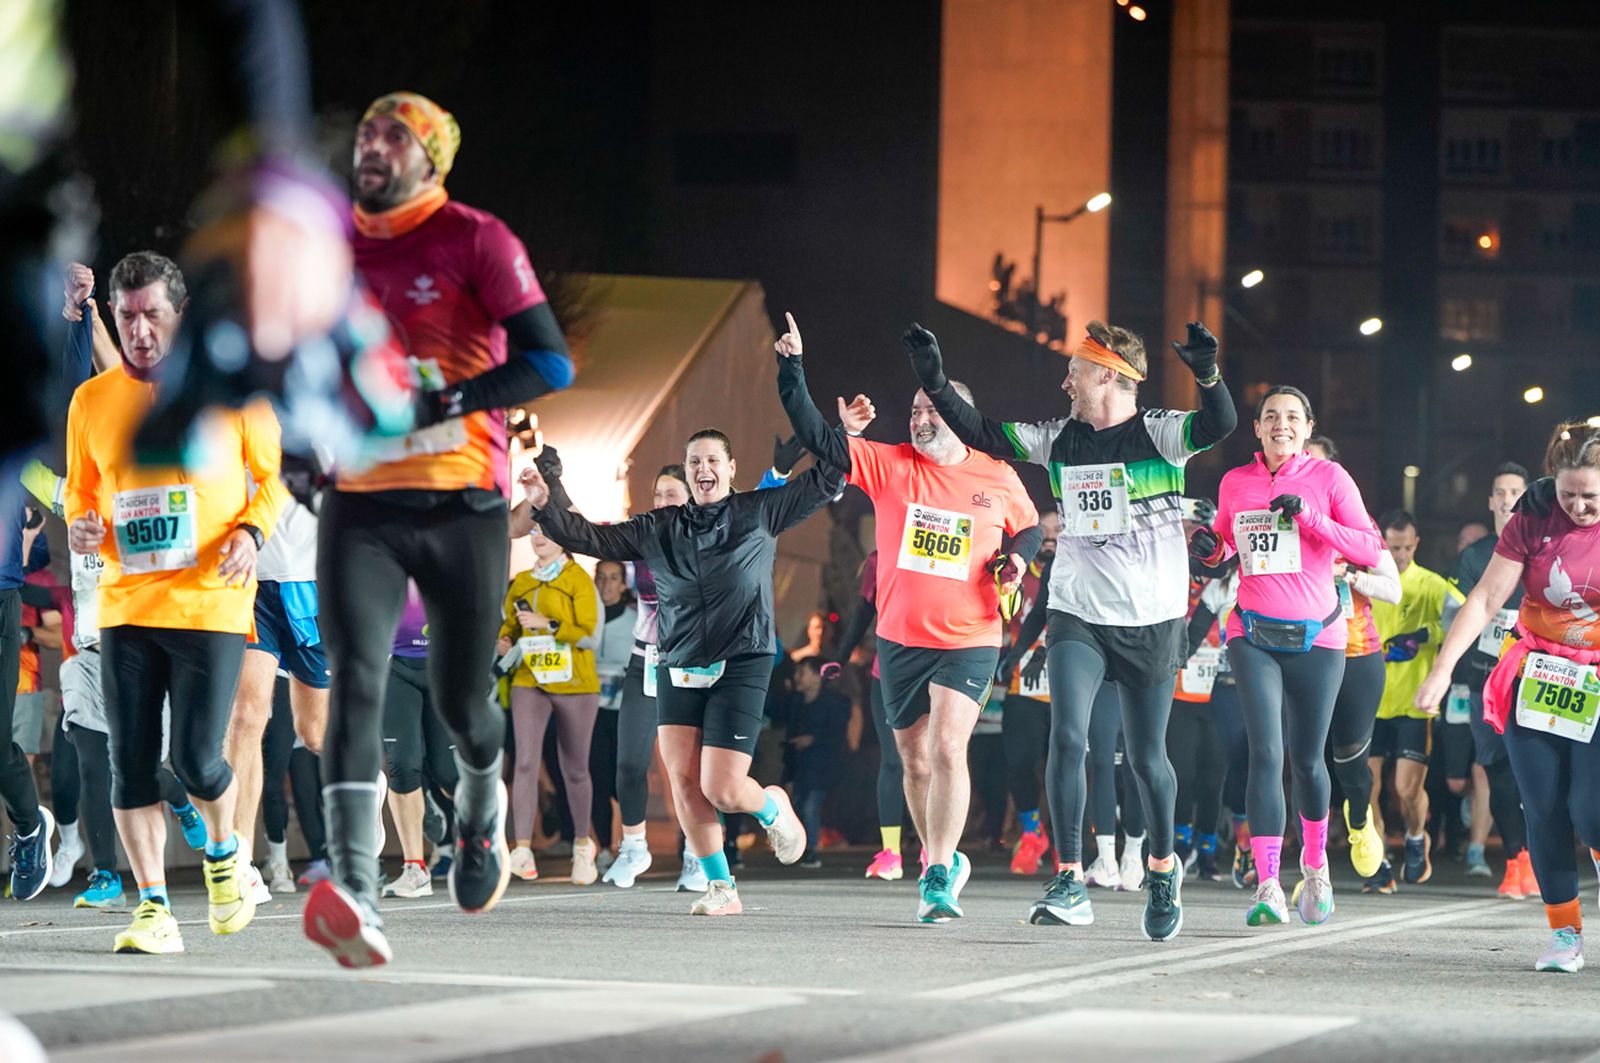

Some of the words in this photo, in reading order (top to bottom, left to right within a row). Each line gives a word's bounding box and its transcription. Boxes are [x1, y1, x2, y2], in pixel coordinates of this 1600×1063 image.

[1095, 472, 1104, 480] DE
[126, 498, 148, 508] NOCHE
[150, 496, 159, 505] DE
[1078, 489, 1112, 512] 336
[912, 520, 926, 528] SN
[921, 513, 941, 523] NOCHE
[1246, 516, 1263, 524] NOCHE
[126, 516, 178, 545] 9507
[913, 529, 962, 556] 5666
[1248, 532, 1279, 552] 337
[530, 652, 560, 667] 8262
[1531, 670, 1548, 679] SAN
[1542, 663, 1567, 675] NOCHE
[1568, 669, 1578, 678] DE
[1534, 681, 1586, 713] 7503
